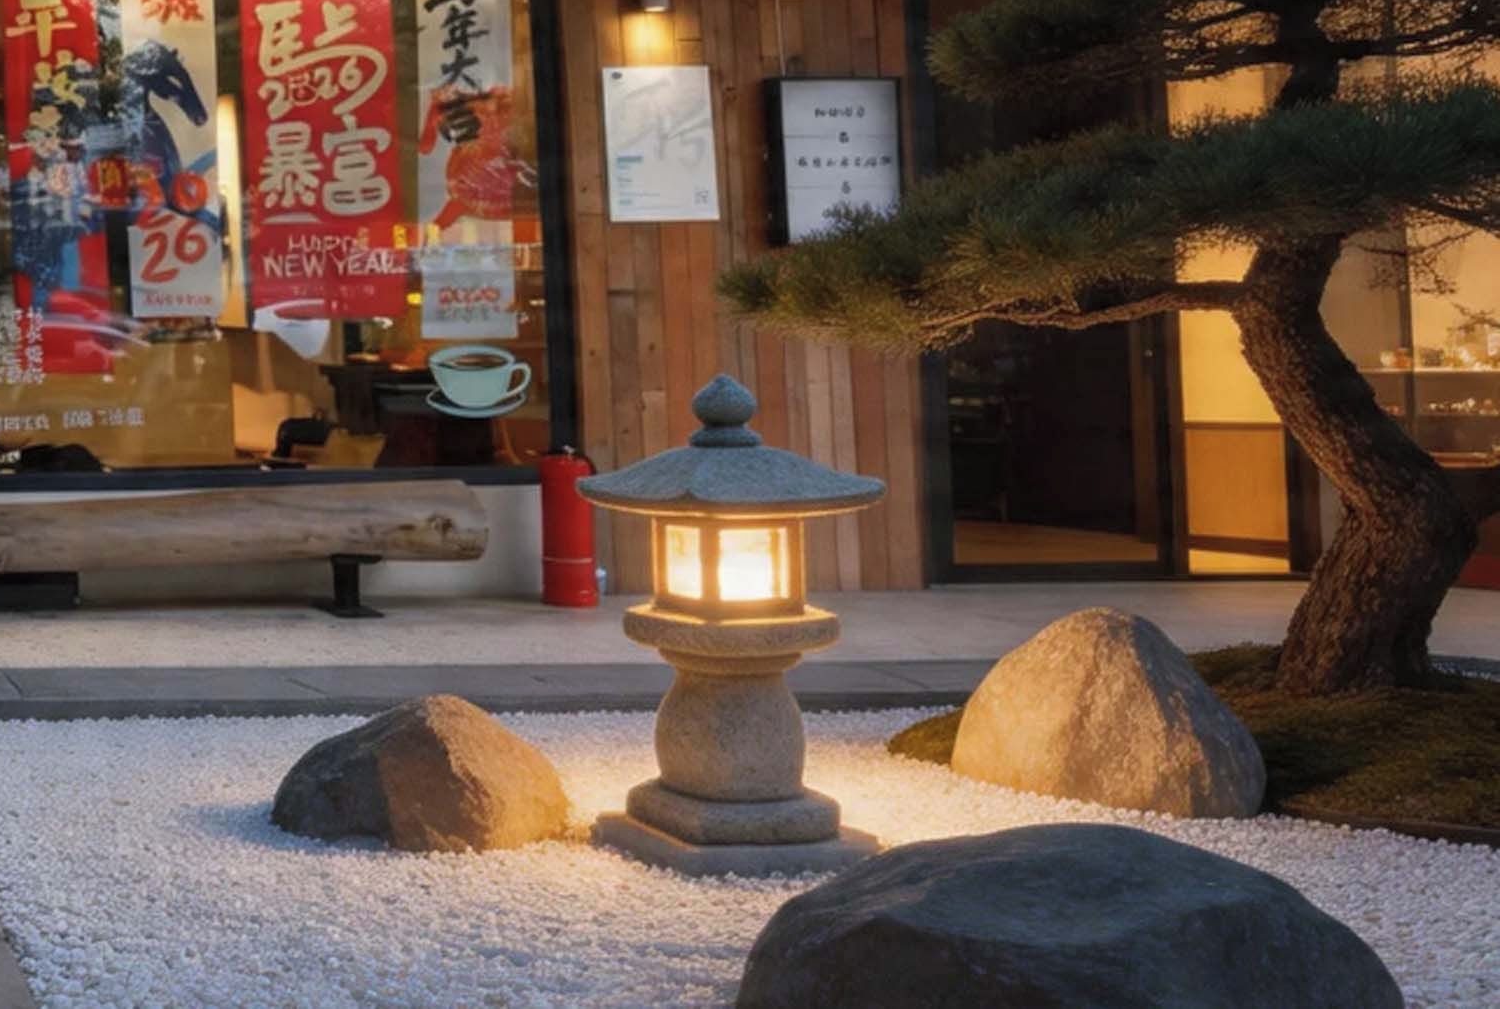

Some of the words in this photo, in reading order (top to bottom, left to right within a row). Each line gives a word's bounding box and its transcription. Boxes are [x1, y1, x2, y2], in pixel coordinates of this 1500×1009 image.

[258, 113, 392, 217] 暴富
[140, 218, 209, 284] 26
[262, 251, 327, 278] NEW
